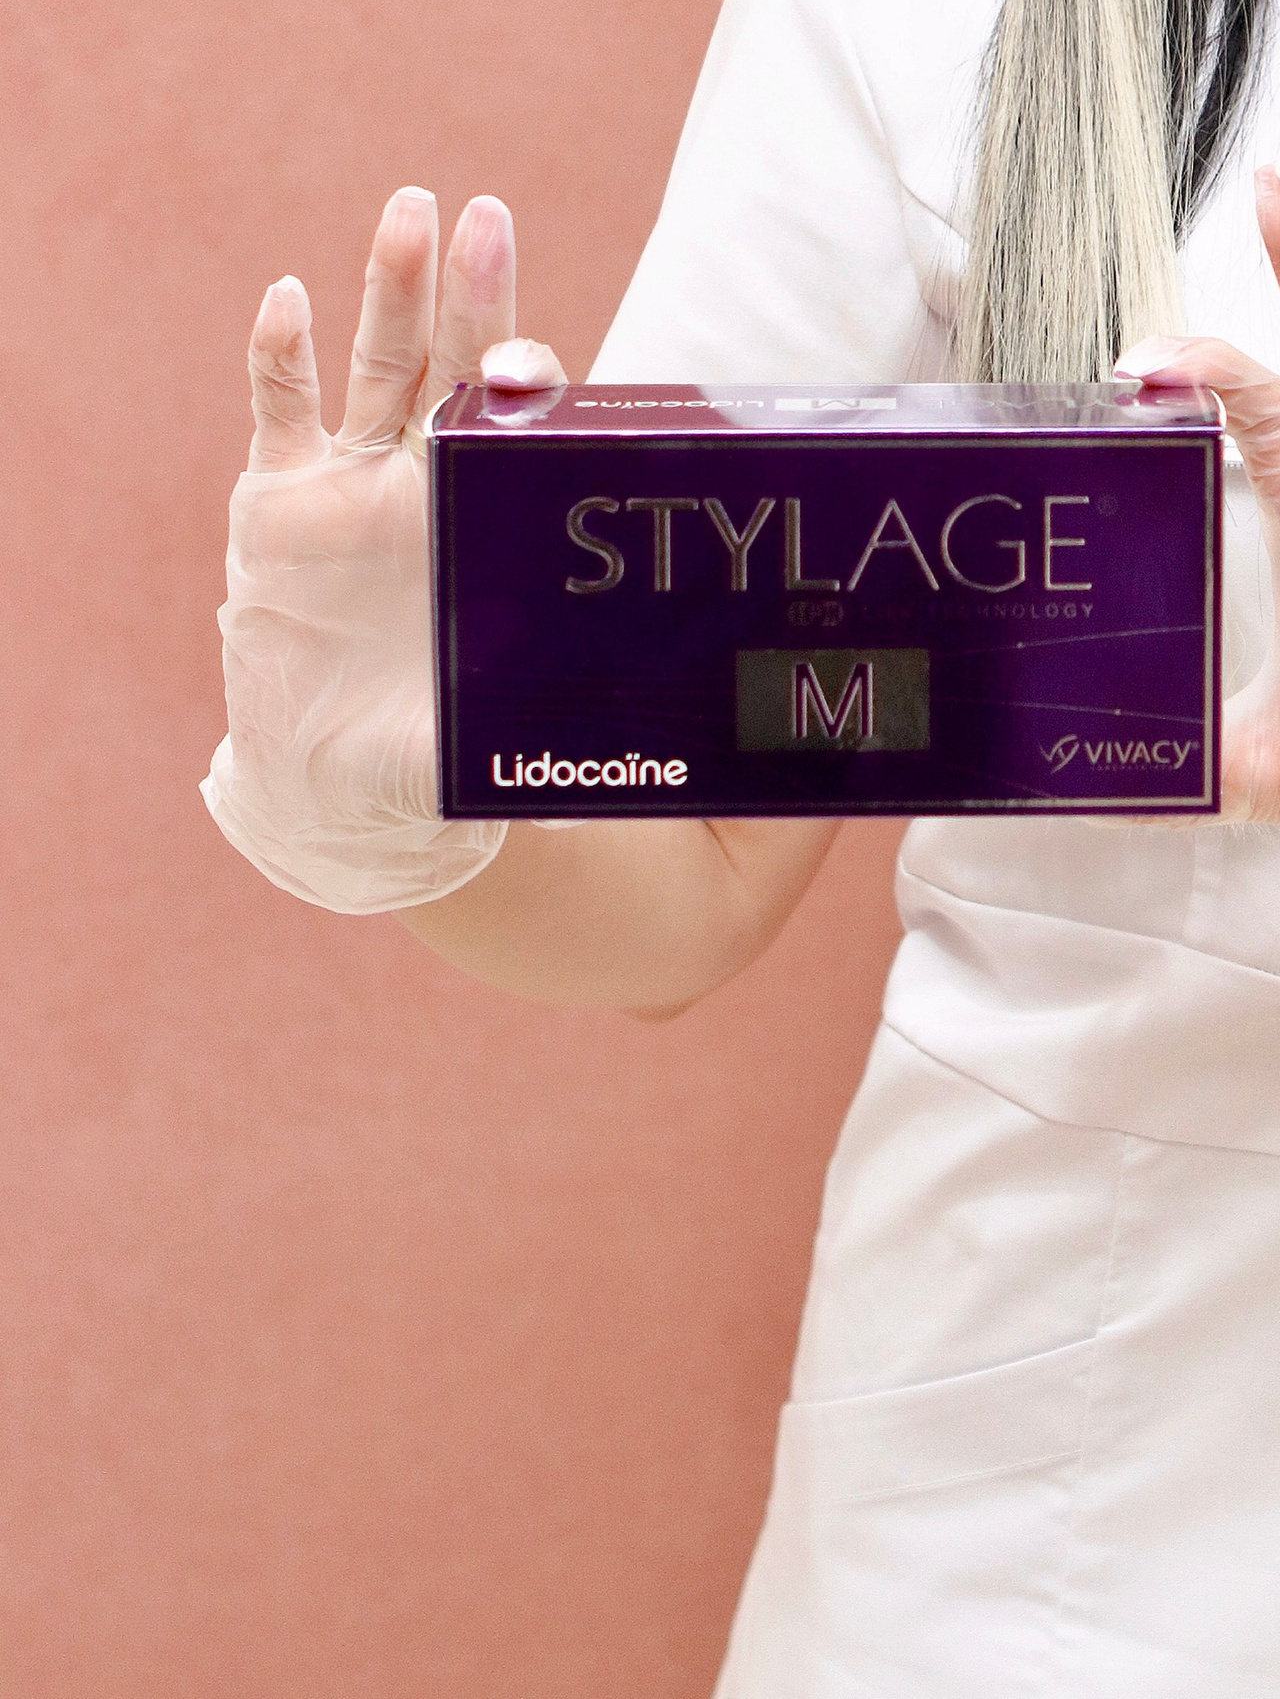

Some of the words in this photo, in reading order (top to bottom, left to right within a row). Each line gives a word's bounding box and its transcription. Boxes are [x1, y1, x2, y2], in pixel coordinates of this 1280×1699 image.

[566, 493, 1093, 593] STYLAGE
[793, 662, 873, 738] M
[493, 750, 688, 787] Lidocaïne
[1084, 740, 1192, 770] VIVACY
